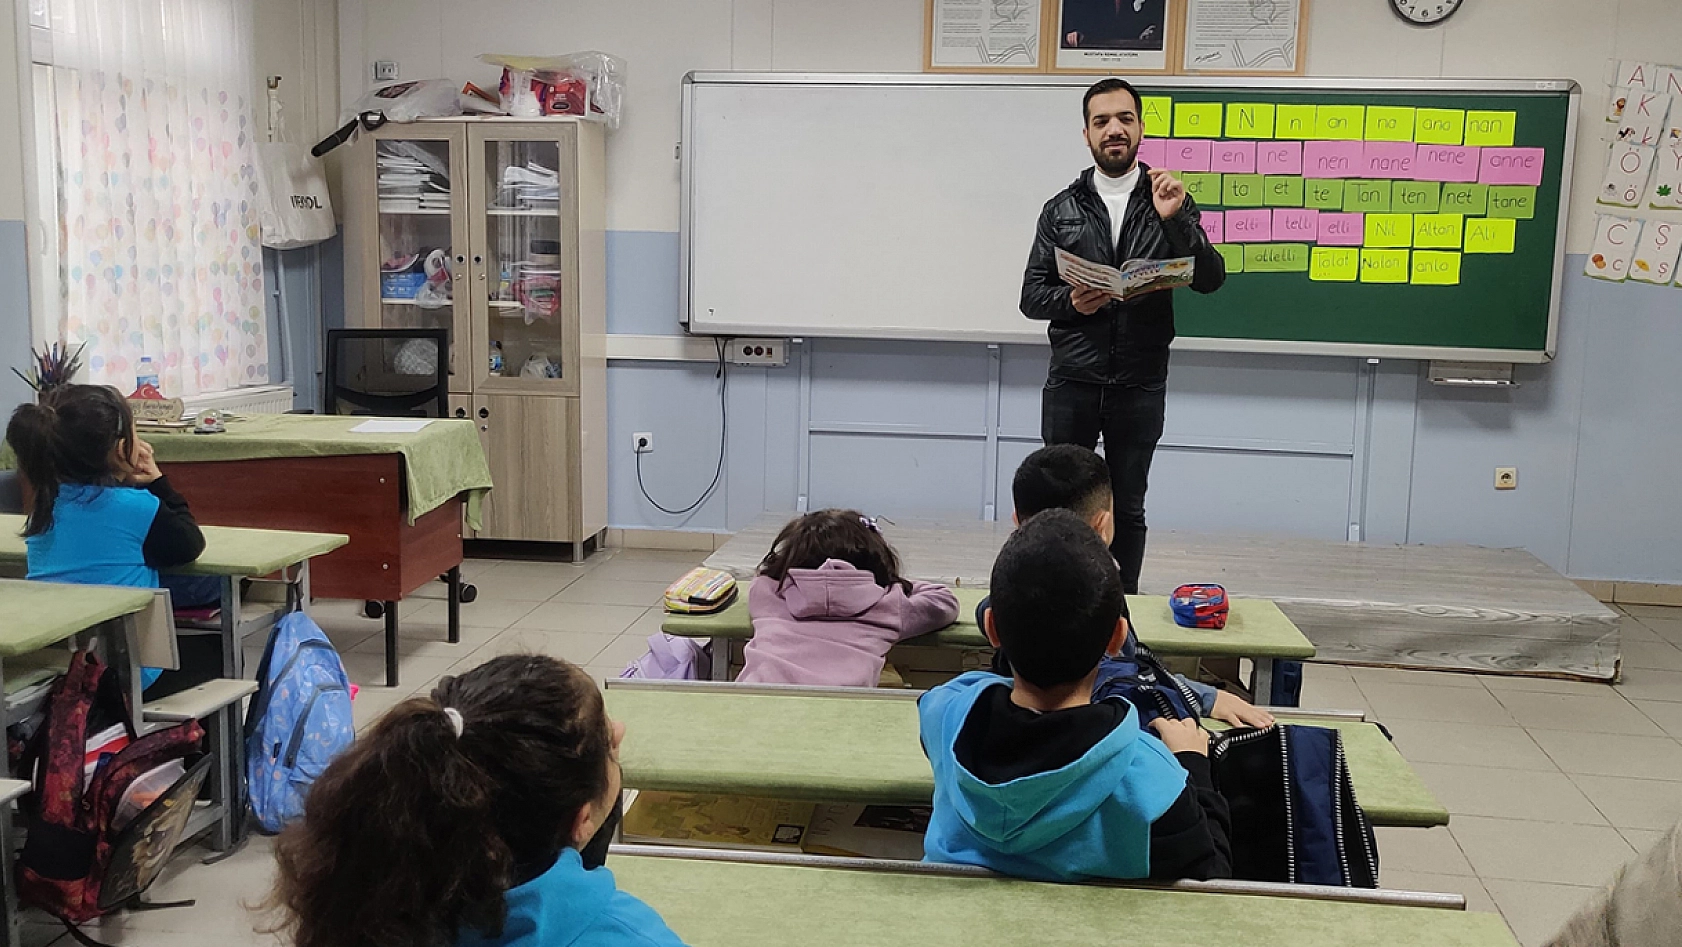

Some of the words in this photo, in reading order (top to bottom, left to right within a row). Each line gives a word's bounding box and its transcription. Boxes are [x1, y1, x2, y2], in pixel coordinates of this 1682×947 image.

[1628, 66, 1645, 87] A
[1638, 94, 1655, 116] K
[1143, 101, 1162, 122] A
[1189, 114, 1200, 125] a
[1239, 107, 1255, 129] N
[1290, 118, 1302, 130] n
[1327, 116, 1348, 129] an
[1377, 118, 1396, 129] na
[1422, 118, 1450, 131] ana
[1469, 118, 1502, 133] nan
[1181, 147, 1193, 159] e
[1222, 151, 1244, 163] en
[1267, 149, 1288, 163] ne
[1318, 155, 1349, 170] nen
[1370, 156, 1411, 171] nane
[1428, 149, 1466, 164] nene
[1490, 154, 1535, 168] anne
[1620, 147, 1641, 174] Ö
[1188, 178, 1204, 193] at
[1232, 180, 1249, 196] ta
[1274, 180, 1289, 195] et
[1313, 185, 1330, 201] te
[1351, 183, 1380, 203] Tan
[1401, 187, 1427, 204] ten
[1446, 188, 1472, 204] net
[1493, 193, 1527, 209] tane
[1624, 184, 1636, 201] ö
[1375, 222, 1396, 236] Nil
[1470, 225, 1496, 241] Ali
[1607, 223, 1628, 244] C
[1655, 224, 1671, 250] Ş
[1613, 259, 1624, 271] c
[1658, 262, 1669, 278] ş
